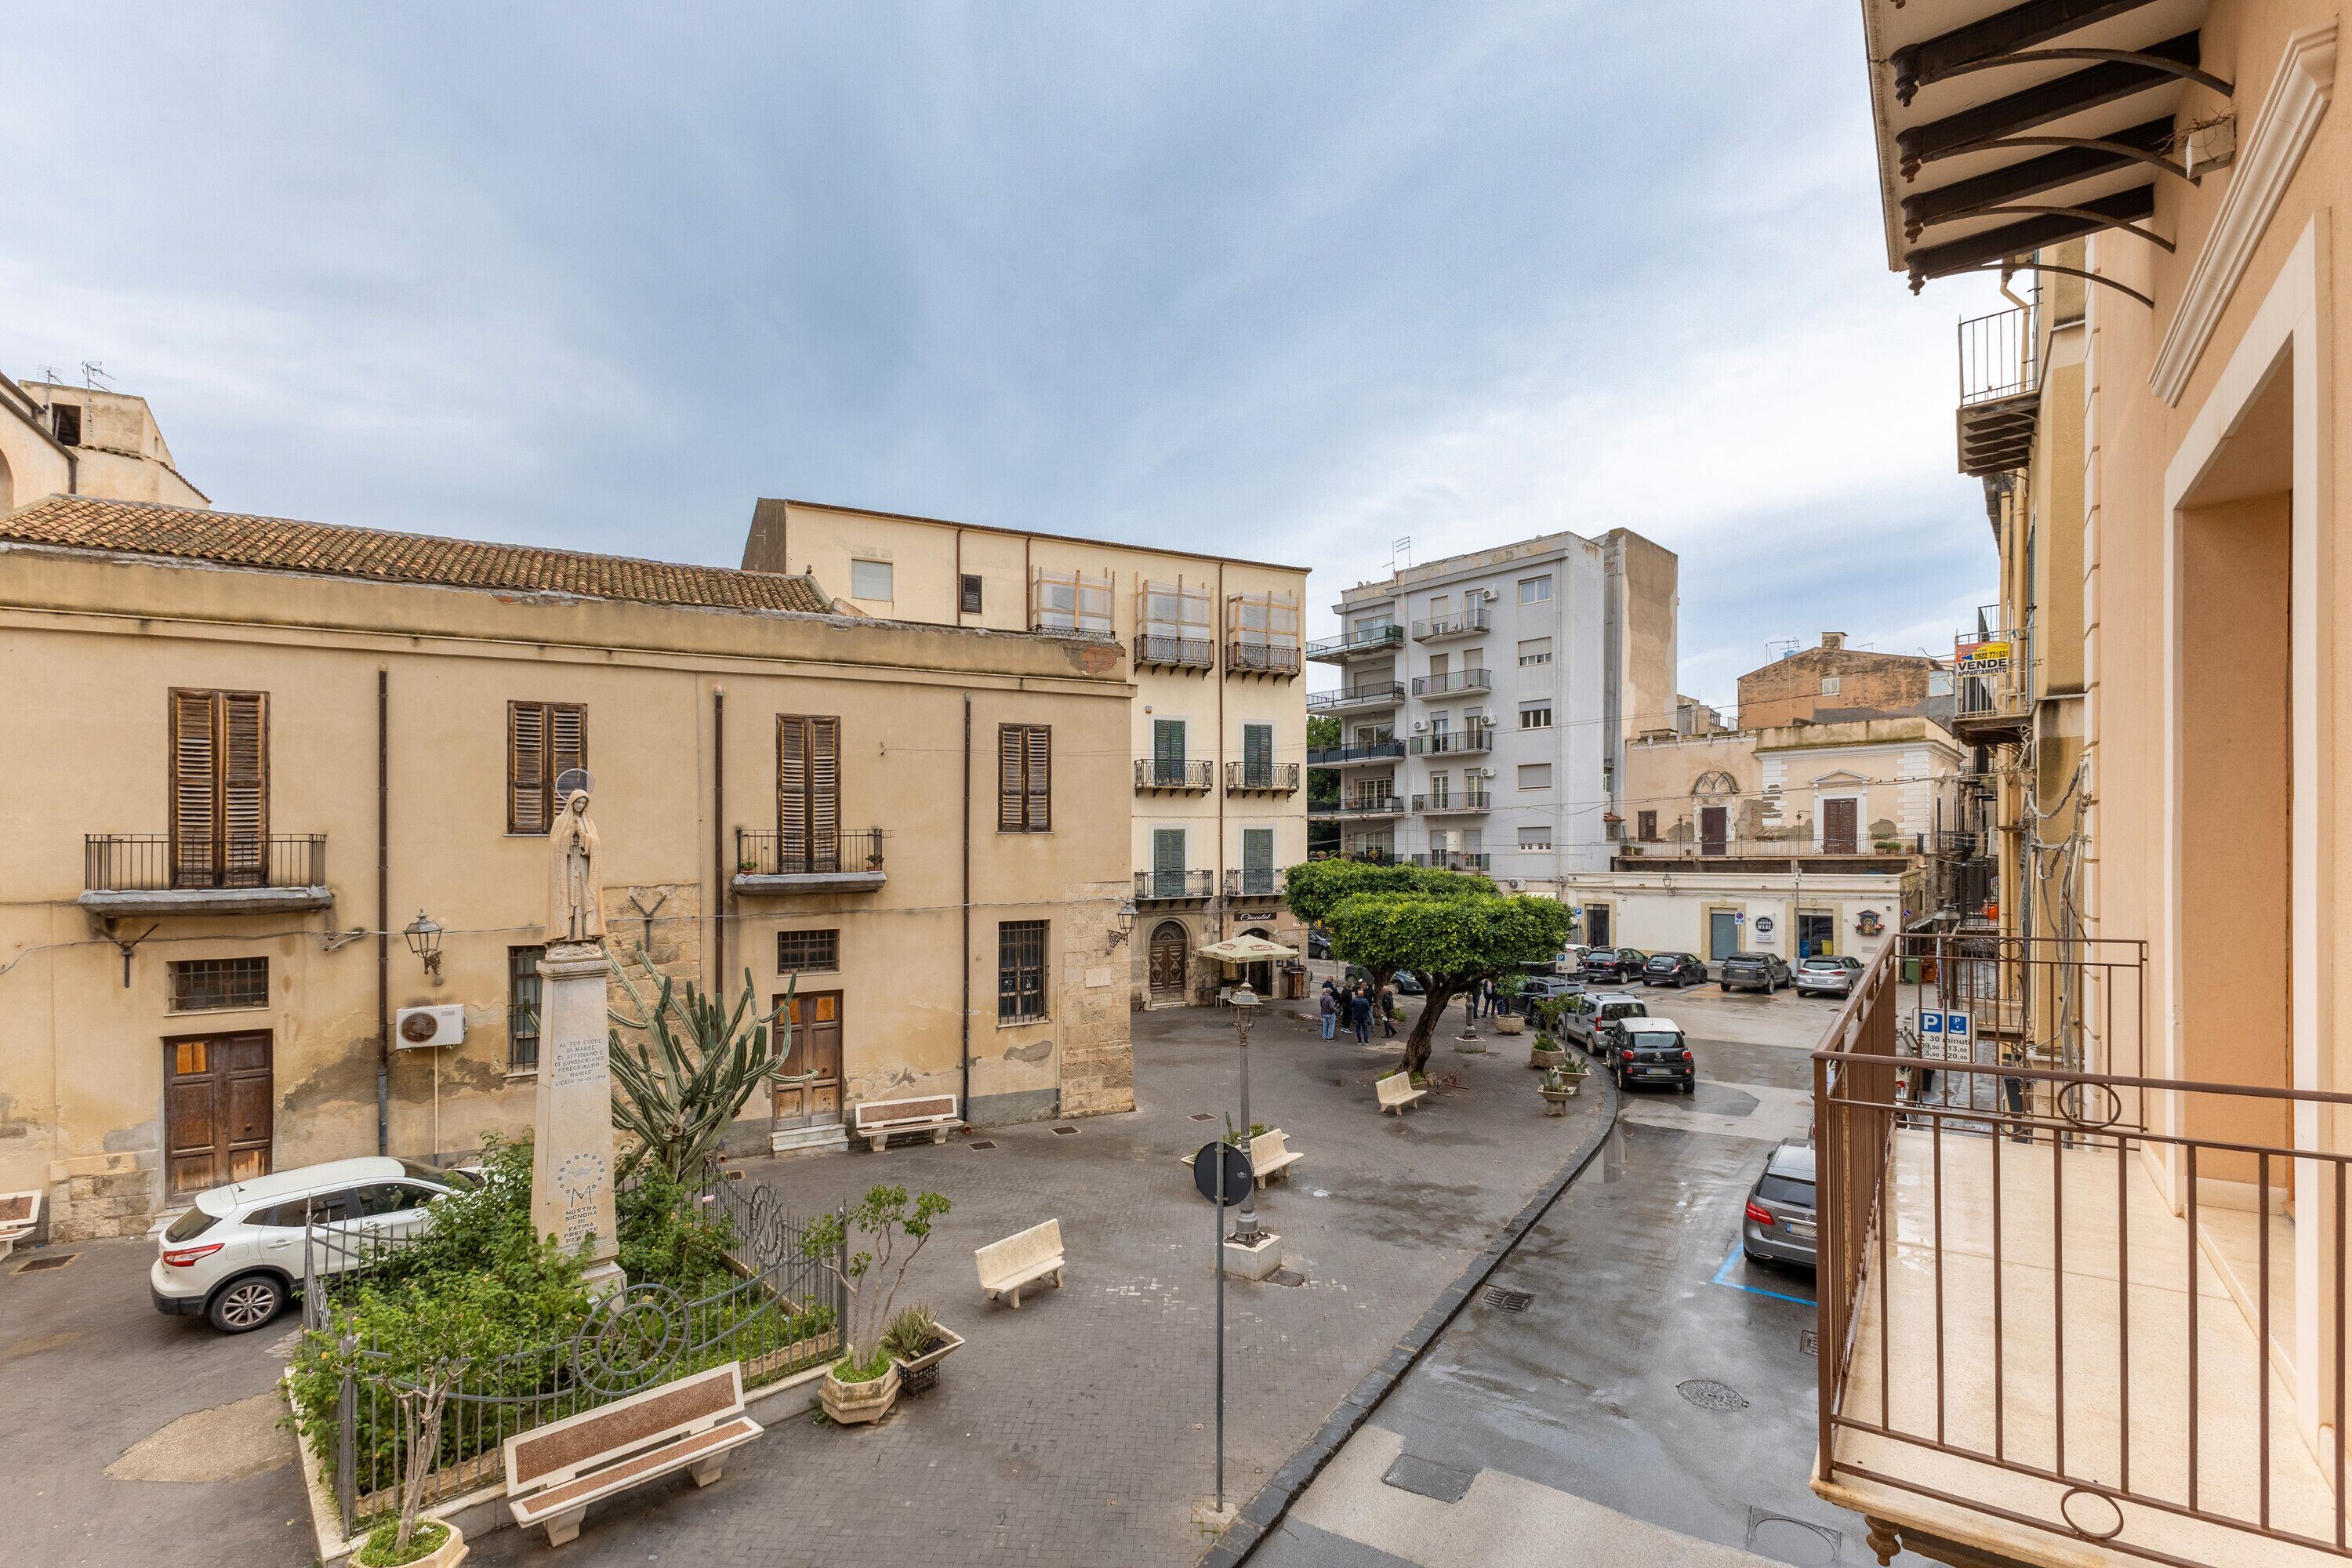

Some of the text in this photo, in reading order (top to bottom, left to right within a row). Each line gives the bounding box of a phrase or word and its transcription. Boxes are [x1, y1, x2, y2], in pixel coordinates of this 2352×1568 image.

[1974, 652, 1987, 660] 0922
[1957, 659, 2007, 671] VENDE
[1957, 667, 2007, 677] APPARTAMENTO
[1924, 1014, 1938, 1030] P
[567, 1051, 597, 1059] AFFIDIAMO
[1947, 1052, 1968, 1061] 20.00
[563, 1056, 604, 1066] CONSACRIAMO
[558, 1062, 600, 1073] PEREGRINATIO
[565, 1205, 597, 1215] NOSTRA
[568, 1222, 594, 1232] FATIMA
